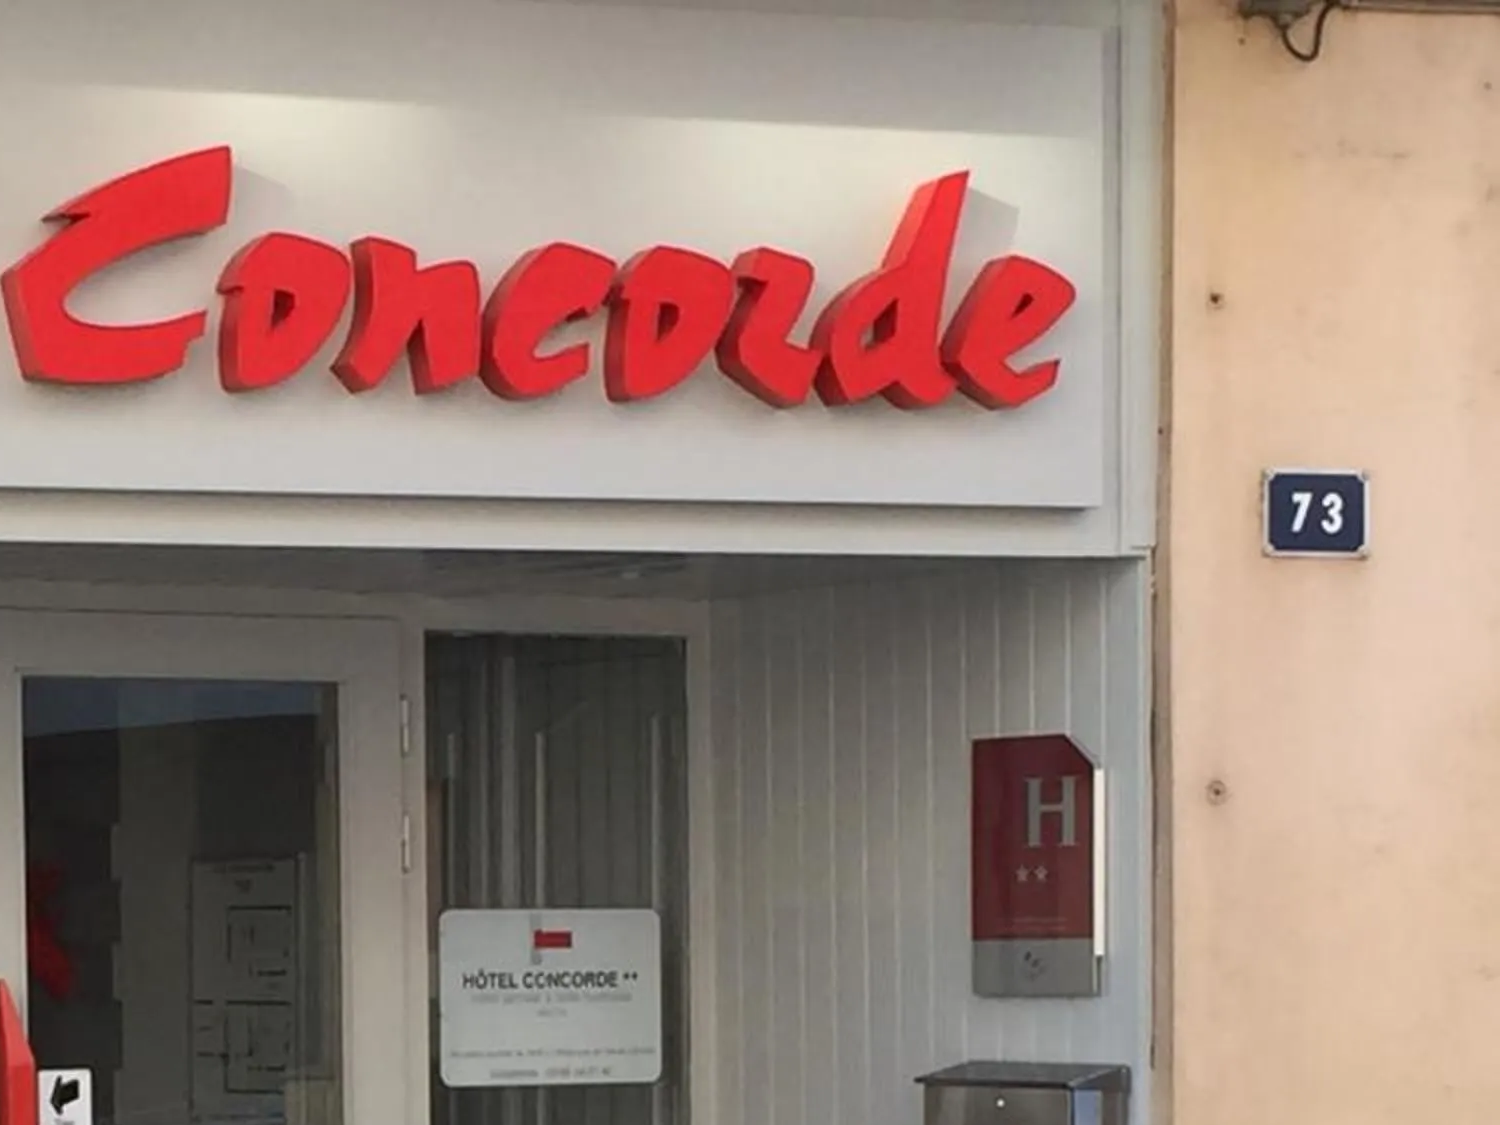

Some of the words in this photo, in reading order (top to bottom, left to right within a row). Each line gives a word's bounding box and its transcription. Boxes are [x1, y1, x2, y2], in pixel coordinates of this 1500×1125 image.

[0, 146, 1076, 410] Concorde
[1290, 491, 1344, 535] 73
[1023, 776, 1081, 847] H
[462, 967, 518, 990] HÔTEL
[522, 971, 618, 990] CONCORDE
